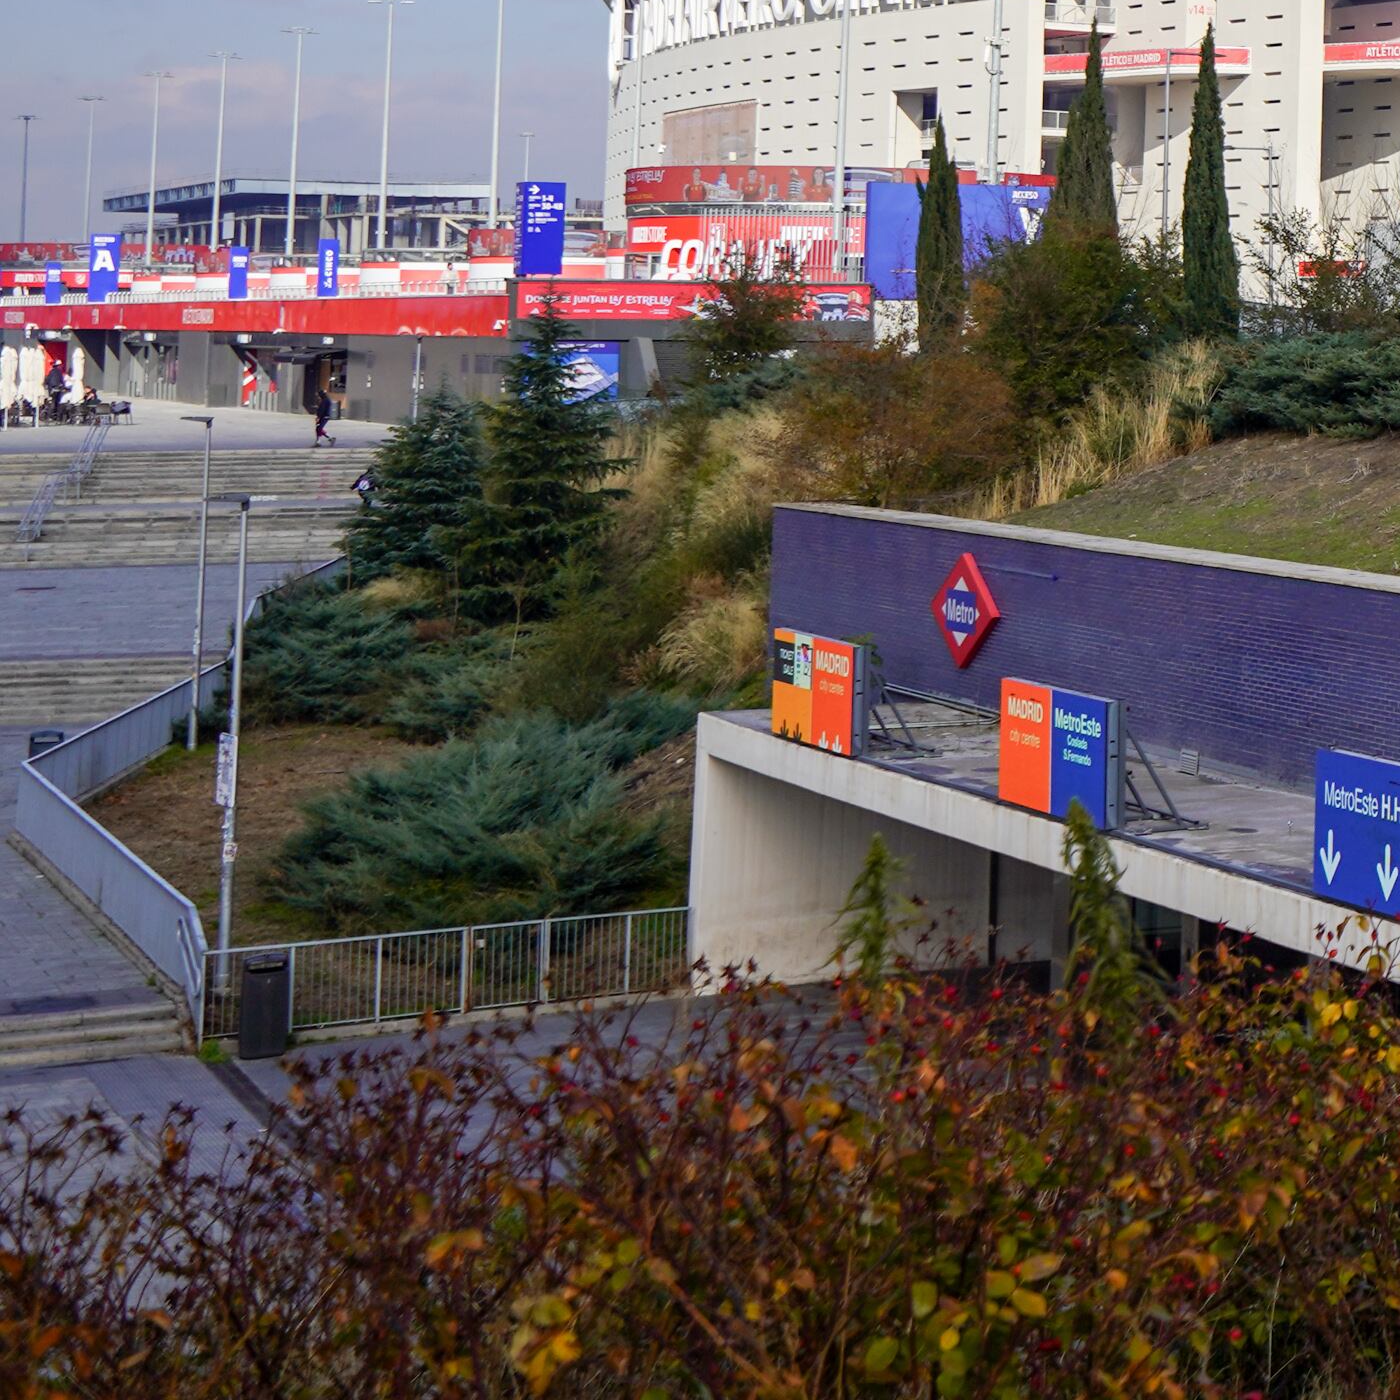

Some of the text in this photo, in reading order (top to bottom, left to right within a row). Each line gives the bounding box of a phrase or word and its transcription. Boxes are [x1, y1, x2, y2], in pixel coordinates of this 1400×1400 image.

[1100, 55, 1128, 66] TLÉTICO
[1134, 53, 1161, 64] MADRID
[93, 250, 115, 271] A
[572, 295, 608, 305] JUNTAN
[609, 295, 624, 306] LAS
[626, 294, 674, 306] ESTRELLAS
[947, 598, 974, 625] Metro
[815, 649, 850, 678] MADRID
[1007, 695, 1044, 724] MADRID
[1054, 707, 1102, 738] MetroEste
[1021, 732, 1041, 749] centre
[1324, 779, 1379, 818] MetroEste
